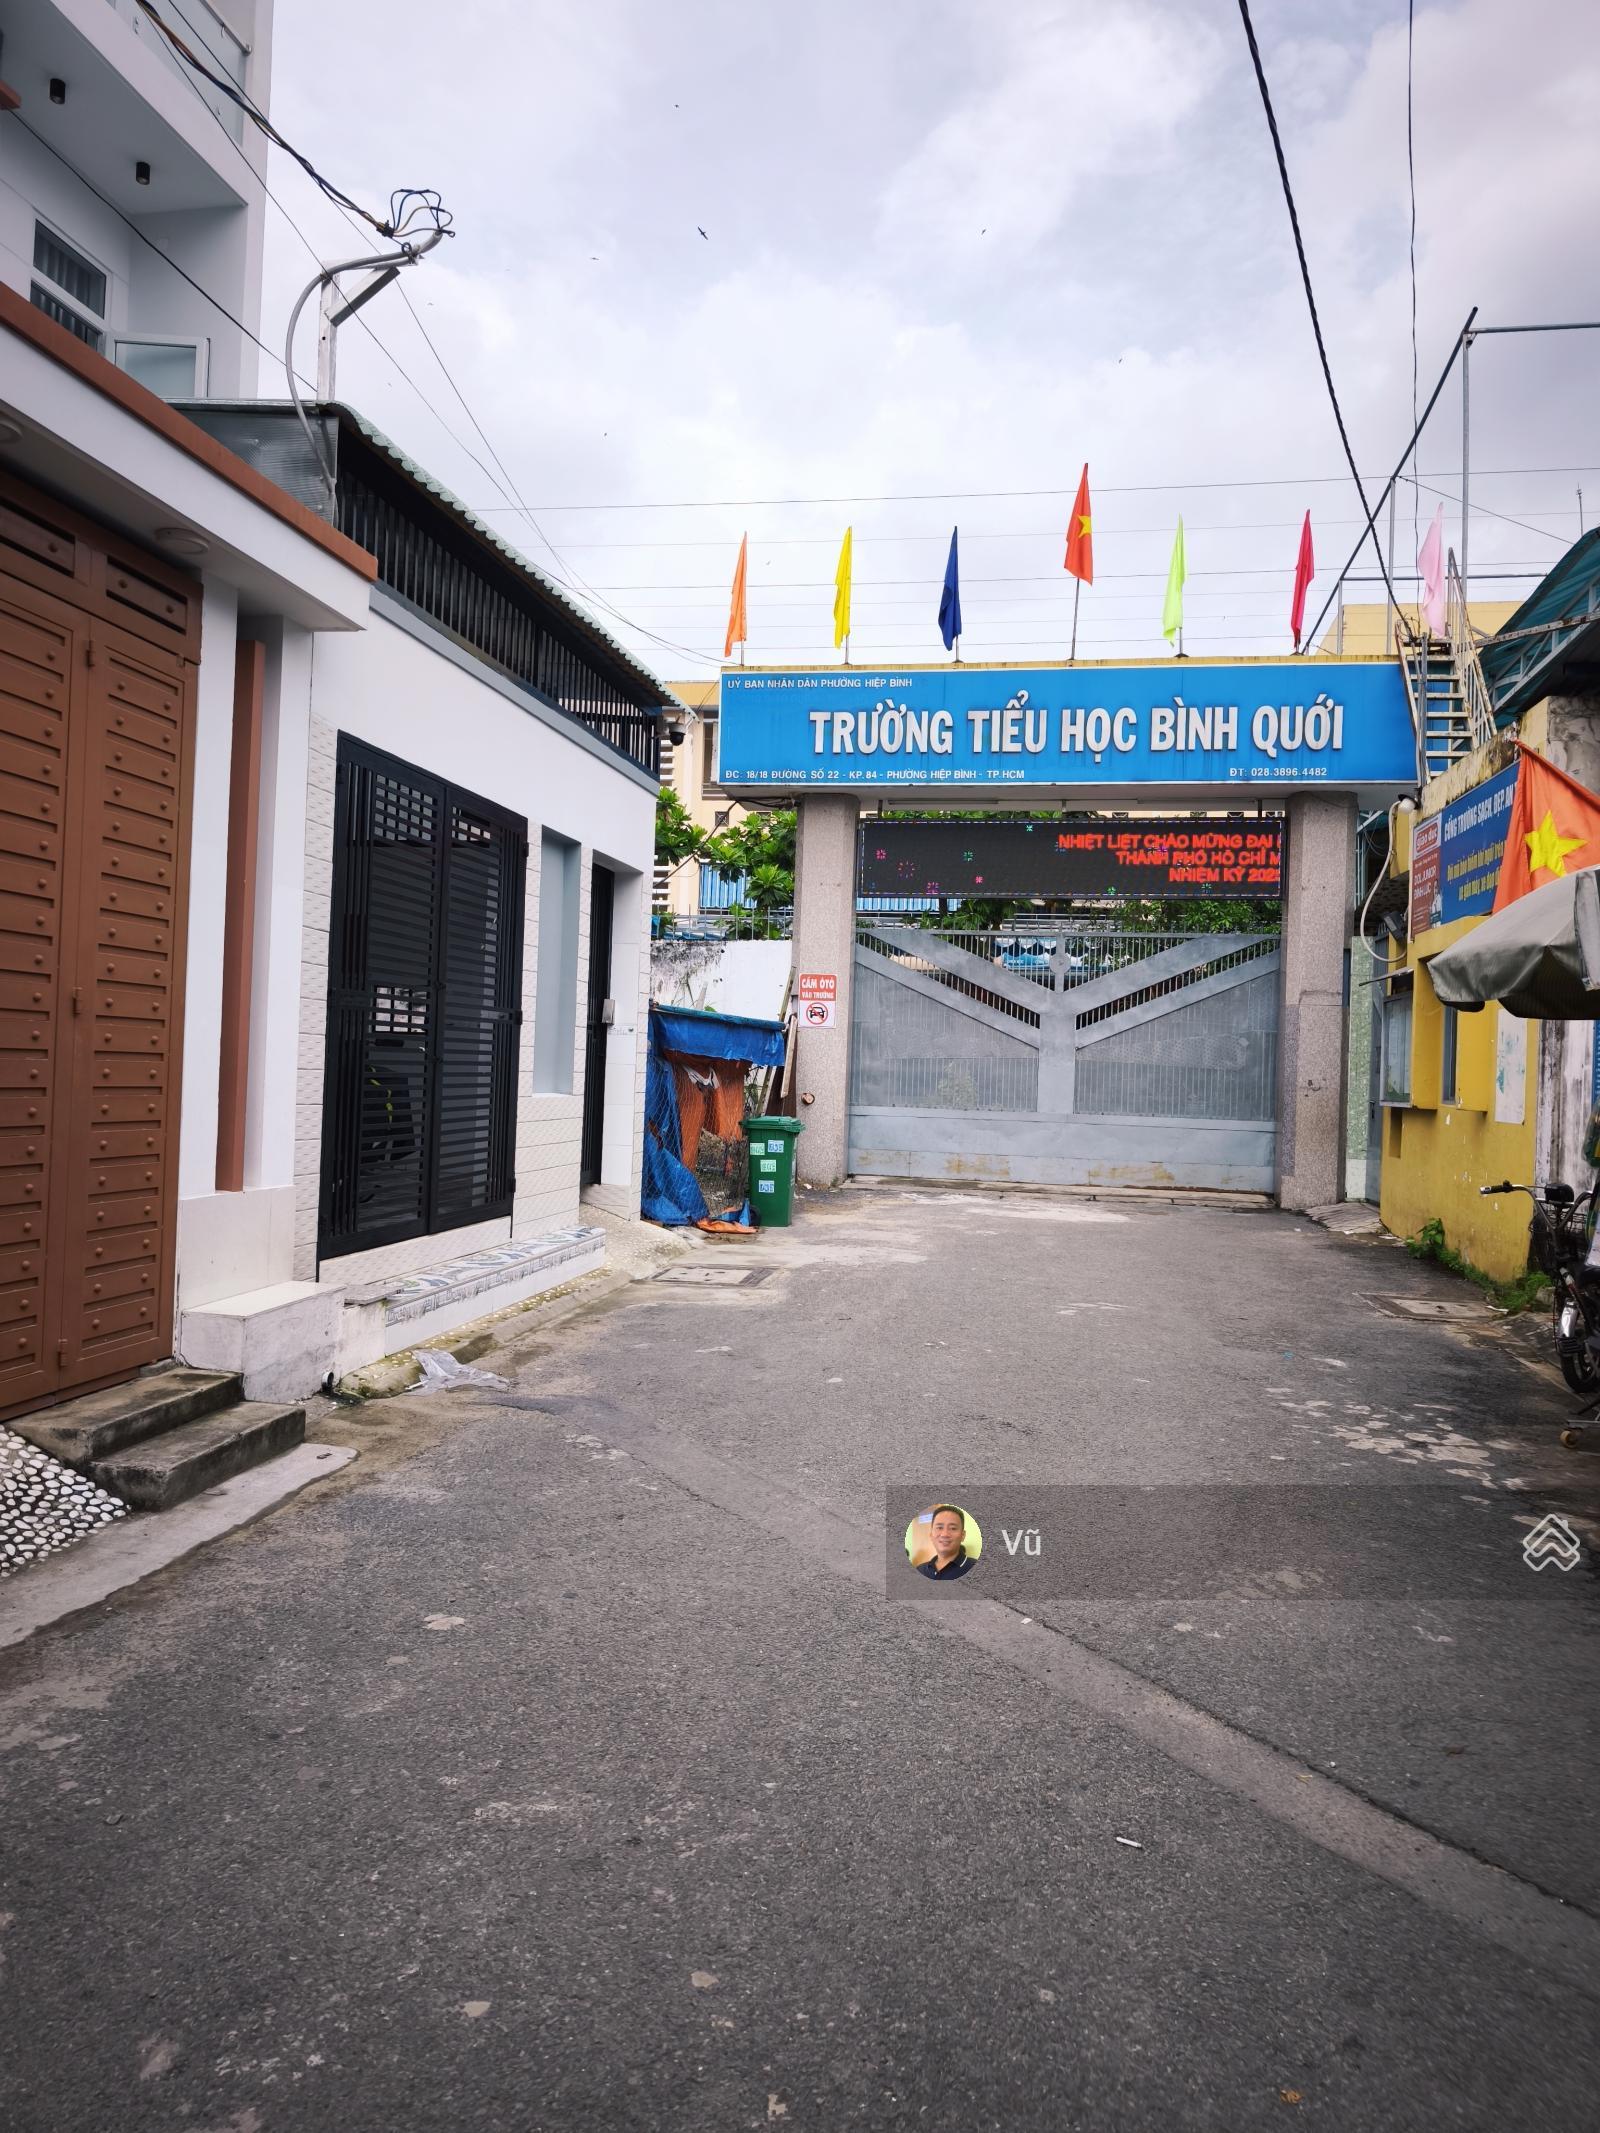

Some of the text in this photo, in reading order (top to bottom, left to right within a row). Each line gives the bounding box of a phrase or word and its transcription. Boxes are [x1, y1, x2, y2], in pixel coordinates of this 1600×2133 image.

[744, 679, 764, 689] BAN
[767, 678, 794, 688] NHÂN
[797, 678, 817, 688] DÂN
[820, 676, 861, 688] PHƯỜNG
[864, 677, 886, 689] HIỆP
[889, 676, 912, 687] BÌNH
[809, 689, 1344, 763] TRƯỜNG TIỂU HỌC BÌNH QUỚI
[746, 770, 768, 780] 18/18
[771, 768, 806, 780] ĐƯỜNG
[810, 767, 825, 780] SỐ
[827, 770, 839, 779] 22
[886, 768, 927, 779] PHƯỜNG
[930, 768, 952, 780] HIỆP
[954, 768, 976, 779] BÌNH
[1251, 767, 1327, 777] 028.3896.4482
[1058, 833, 1104, 850] NHIỆT
[801, 976, 817, 989] CẤM
